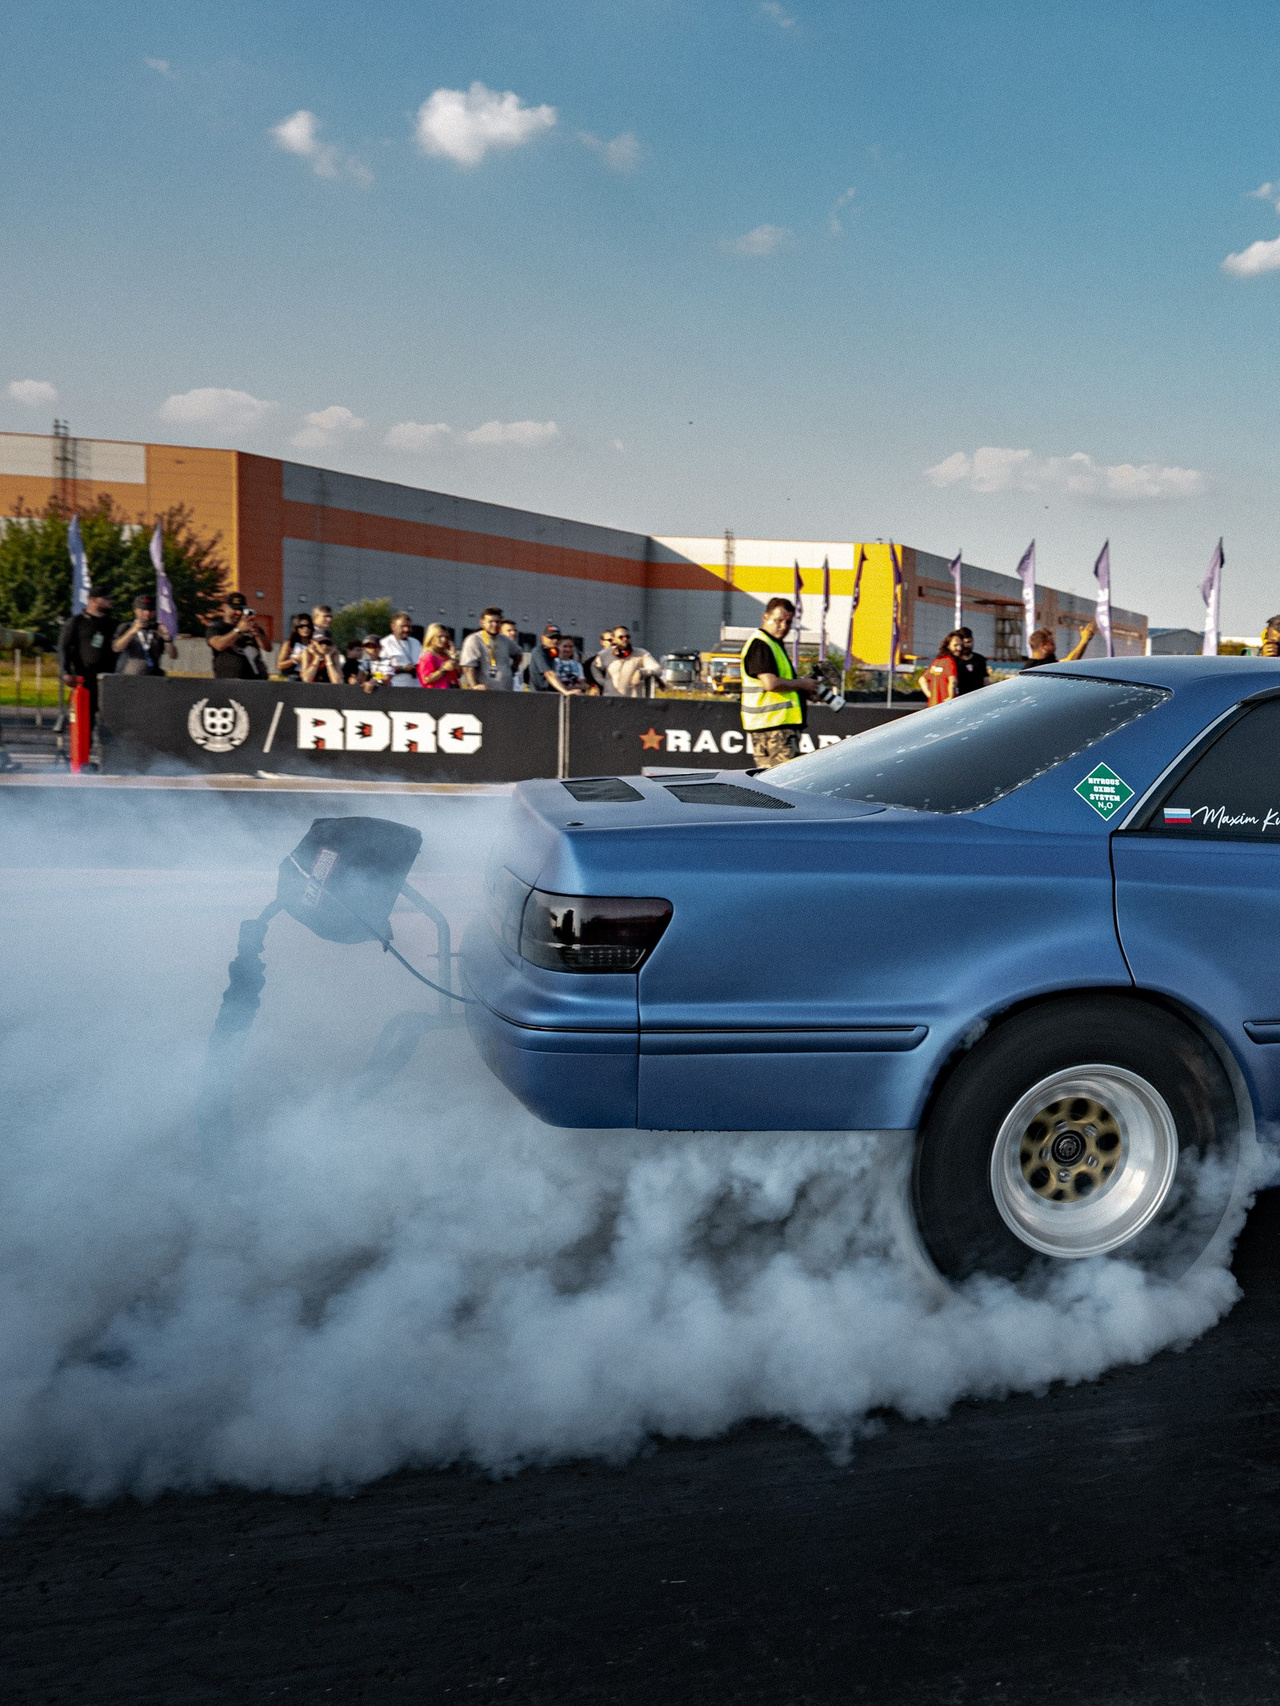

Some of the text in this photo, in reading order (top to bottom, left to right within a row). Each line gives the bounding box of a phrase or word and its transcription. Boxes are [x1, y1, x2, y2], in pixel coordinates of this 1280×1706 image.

[294, 707, 483, 754] RDRC
[1089, 793, 1120, 801] SYSTEM
[1192, 805, 1259, 829] Maxim
